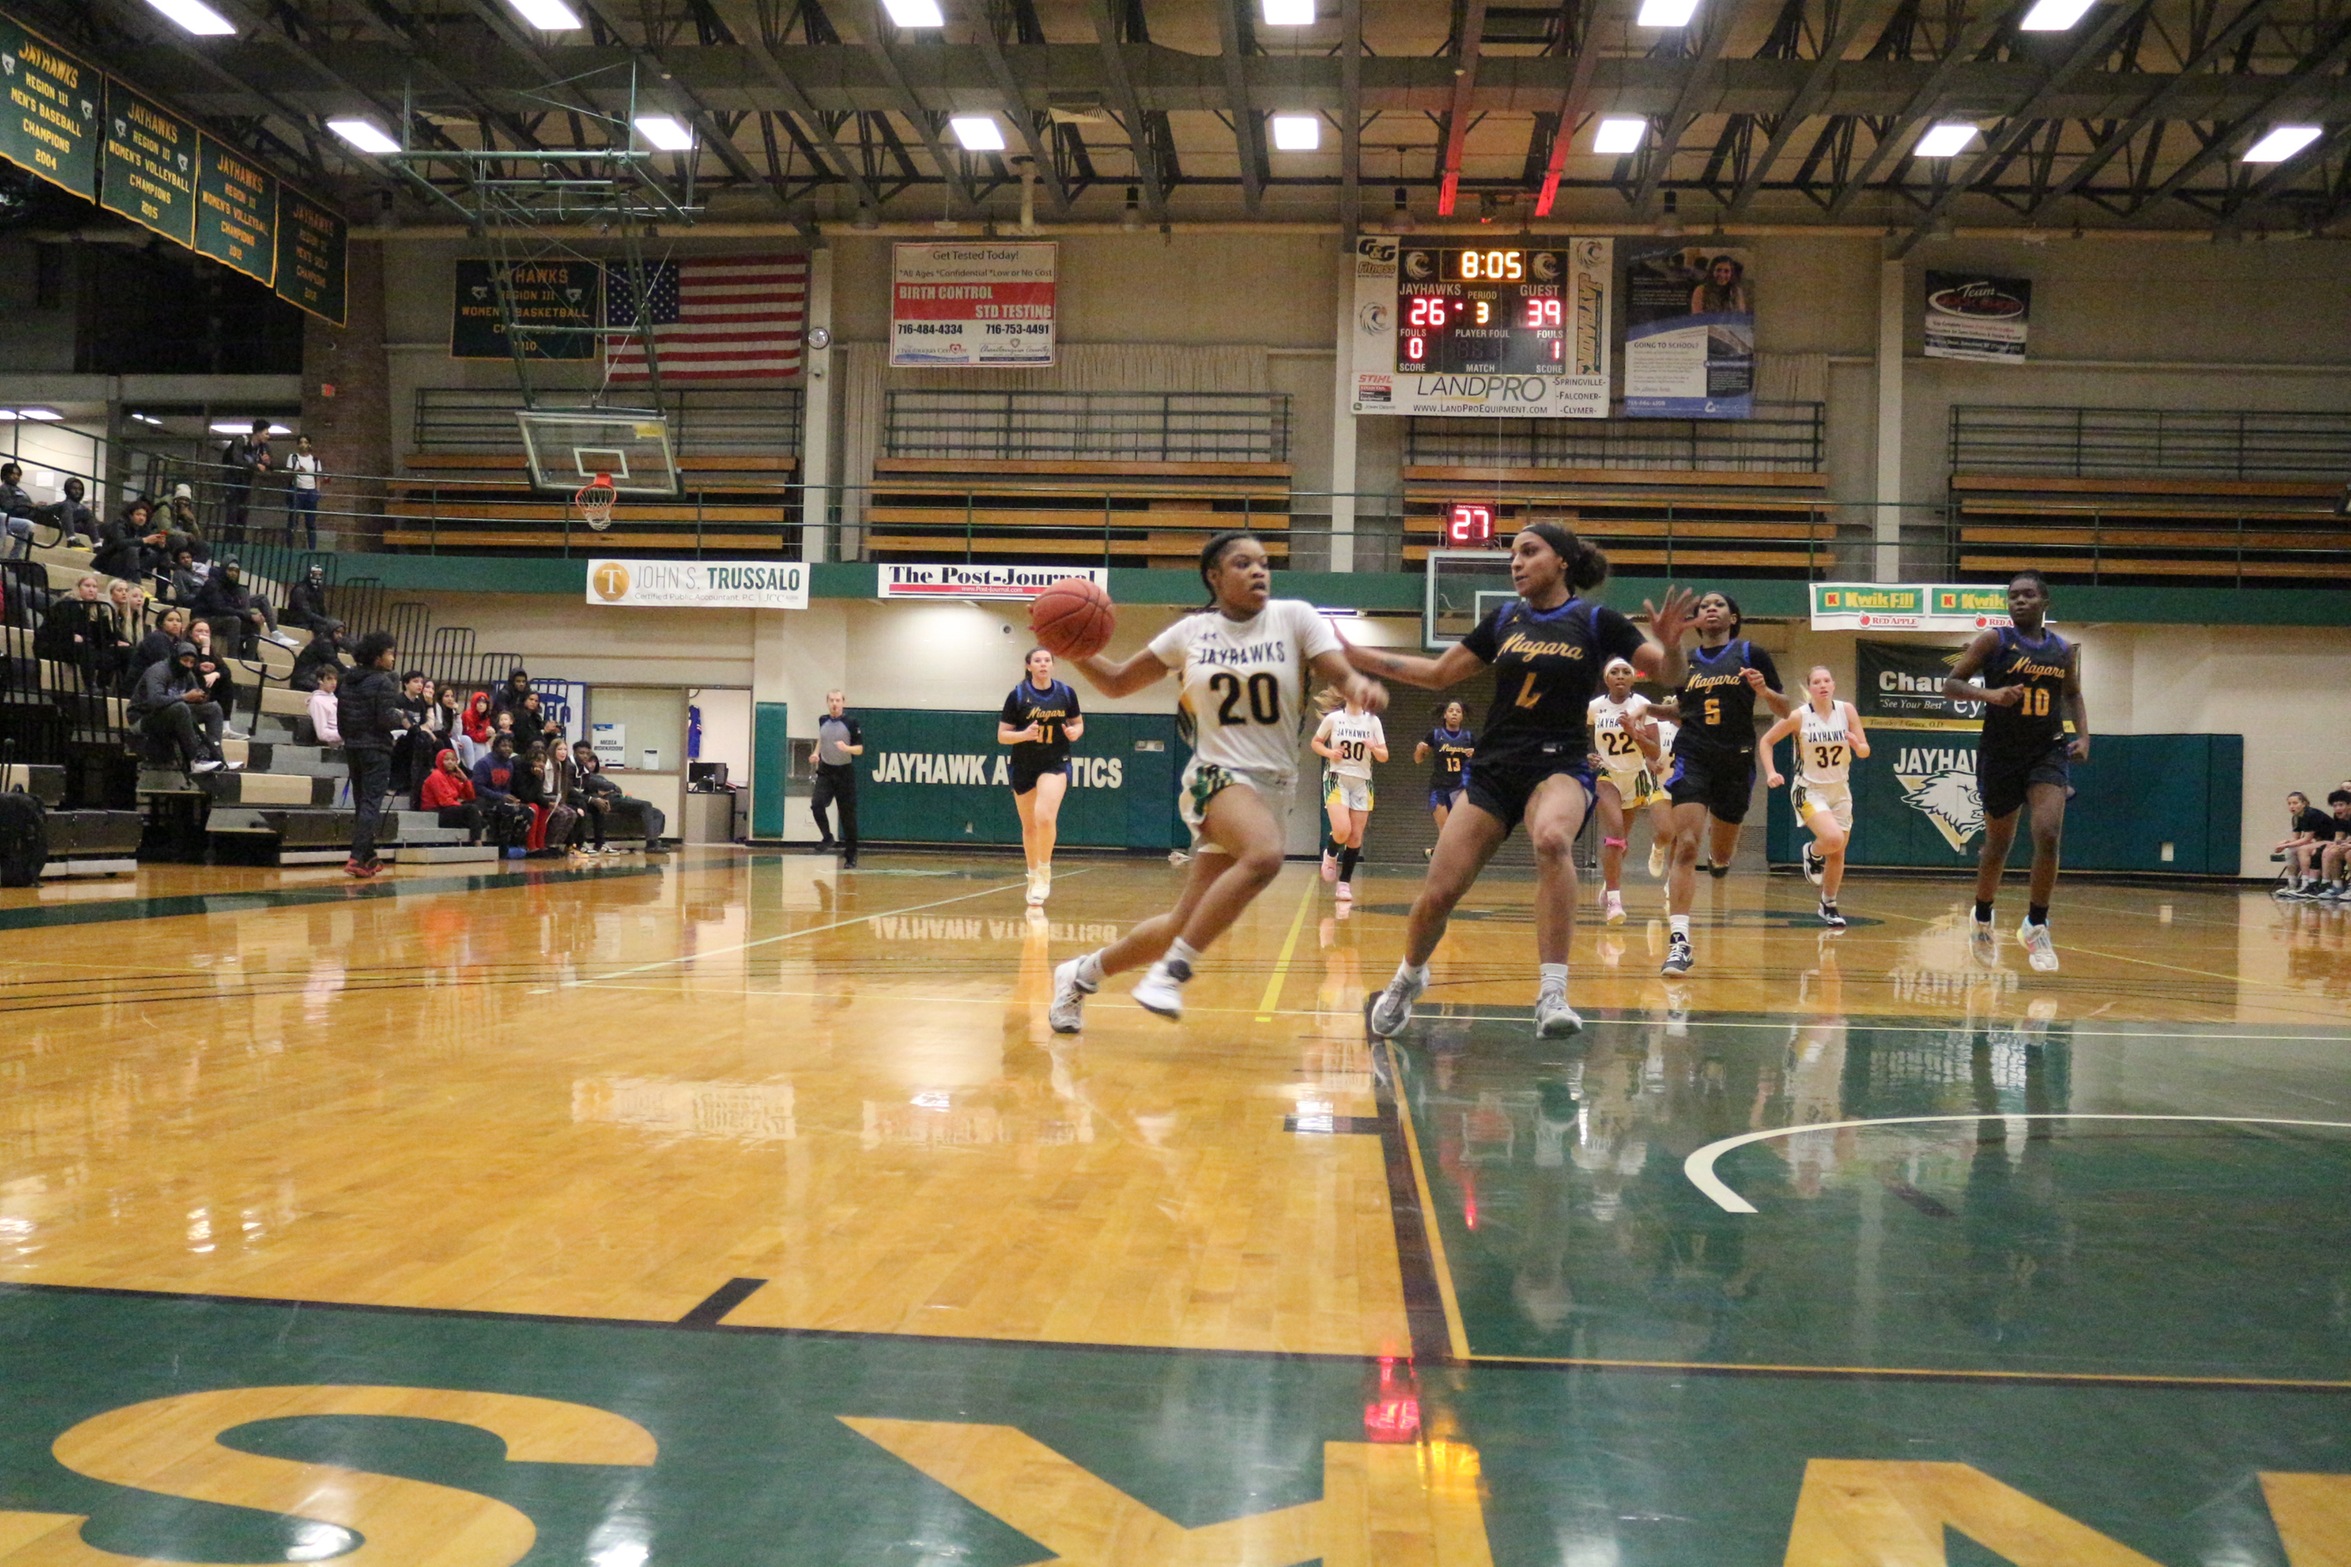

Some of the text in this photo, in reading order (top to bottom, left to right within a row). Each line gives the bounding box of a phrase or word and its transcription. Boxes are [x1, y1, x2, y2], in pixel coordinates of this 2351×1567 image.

[19, 42, 78, 89] JAYHAWKS
[26, 72, 55, 99] REGION
[11, 87, 81, 137] MEN'S BASEBALL
[128, 103, 177, 144] JAYHAWKS
[23, 118, 70, 154] CHAMPIONS
[133, 130, 158, 155] REGION
[36, 149, 56, 170] 2004
[109, 140, 190, 193] WOMEN'S VOLLEYBALL
[217, 154, 263, 194] JAYHAWKS
[130, 174, 171, 204] CHAMPIONS
[933, 251, 1018, 261] Get Tested Today!
[1462, 251, 1522, 279] 8:05
[915, 270, 934, 278] Ages
[900, 286, 993, 299] BIRTH CONTROL
[1399, 284, 1559, 296] JAYHAWKS GUEST
[1468, 291, 1497, 300] PERIOD
[1957, 282, 1995, 298] Team
[516, 308, 589, 317] BASKETBALL
[976, 305, 1051, 318] STD TESTING
[1411, 298, 1445, 325] 26
[1476, 302, 1489, 323] 3
[1528, 300, 1560, 326] 39
[898, 324, 1049, 335] 716-484-4334 716-753-4491
[1456, 329, 1510, 338] PLAYER FOUL
[1537, 330, 1563, 338] FOULS
[1410, 338, 1423, 358] 0
[1554, 341, 1560, 358] 1
[1359, 374, 1392, 383] STIHL
[1466, 364, 1495, 372] MATCH
[1536, 365, 1562, 373] SCORE
[1418, 376, 1546, 402] LANDPRO
[1453, 509, 1488, 539] 27
[636, 566, 679, 589] JOHN
[686, 567, 700, 590] S.
[707, 568, 800, 591] TRUSSALO
[889, 566, 1095, 585] The Post-Jourl
[635, 592, 668, 600] Certified
[1845, 592, 1888, 608] Kwik
[1890, 593, 1914, 608] Fill
[1962, 594, 2004, 609] Kwik
[1872, 617, 1889, 625] RED
[1200, 642, 1285, 664] JAYHAWKS
[1498, 632, 1583, 663] Niagara
[2007, 656, 2066, 678] Niagara
[1685, 673, 1741, 694] Niagara
[1210, 672, 1280, 726] 20
[1901, 700, 1921, 709] Your
[2021, 688, 2049, 716] 10
[1026, 706, 1066, 722] Niagara
[1705, 699, 1721, 725] 5
[1337, 728, 1370, 738] JAYHAWKS
[1597, 718, 1618, 728] JAYHA
[1037, 725, 1054, 744] 11
[1602, 732, 1635, 755] 22
[1340, 740, 1364, 762] 30
[1815, 746, 1843, 768] 32
[1893, 748, 1976, 774] JAYHA
[872, 752, 1122, 788] JAYHAWK ATICS
[1446, 757, 1461, 772] 13
